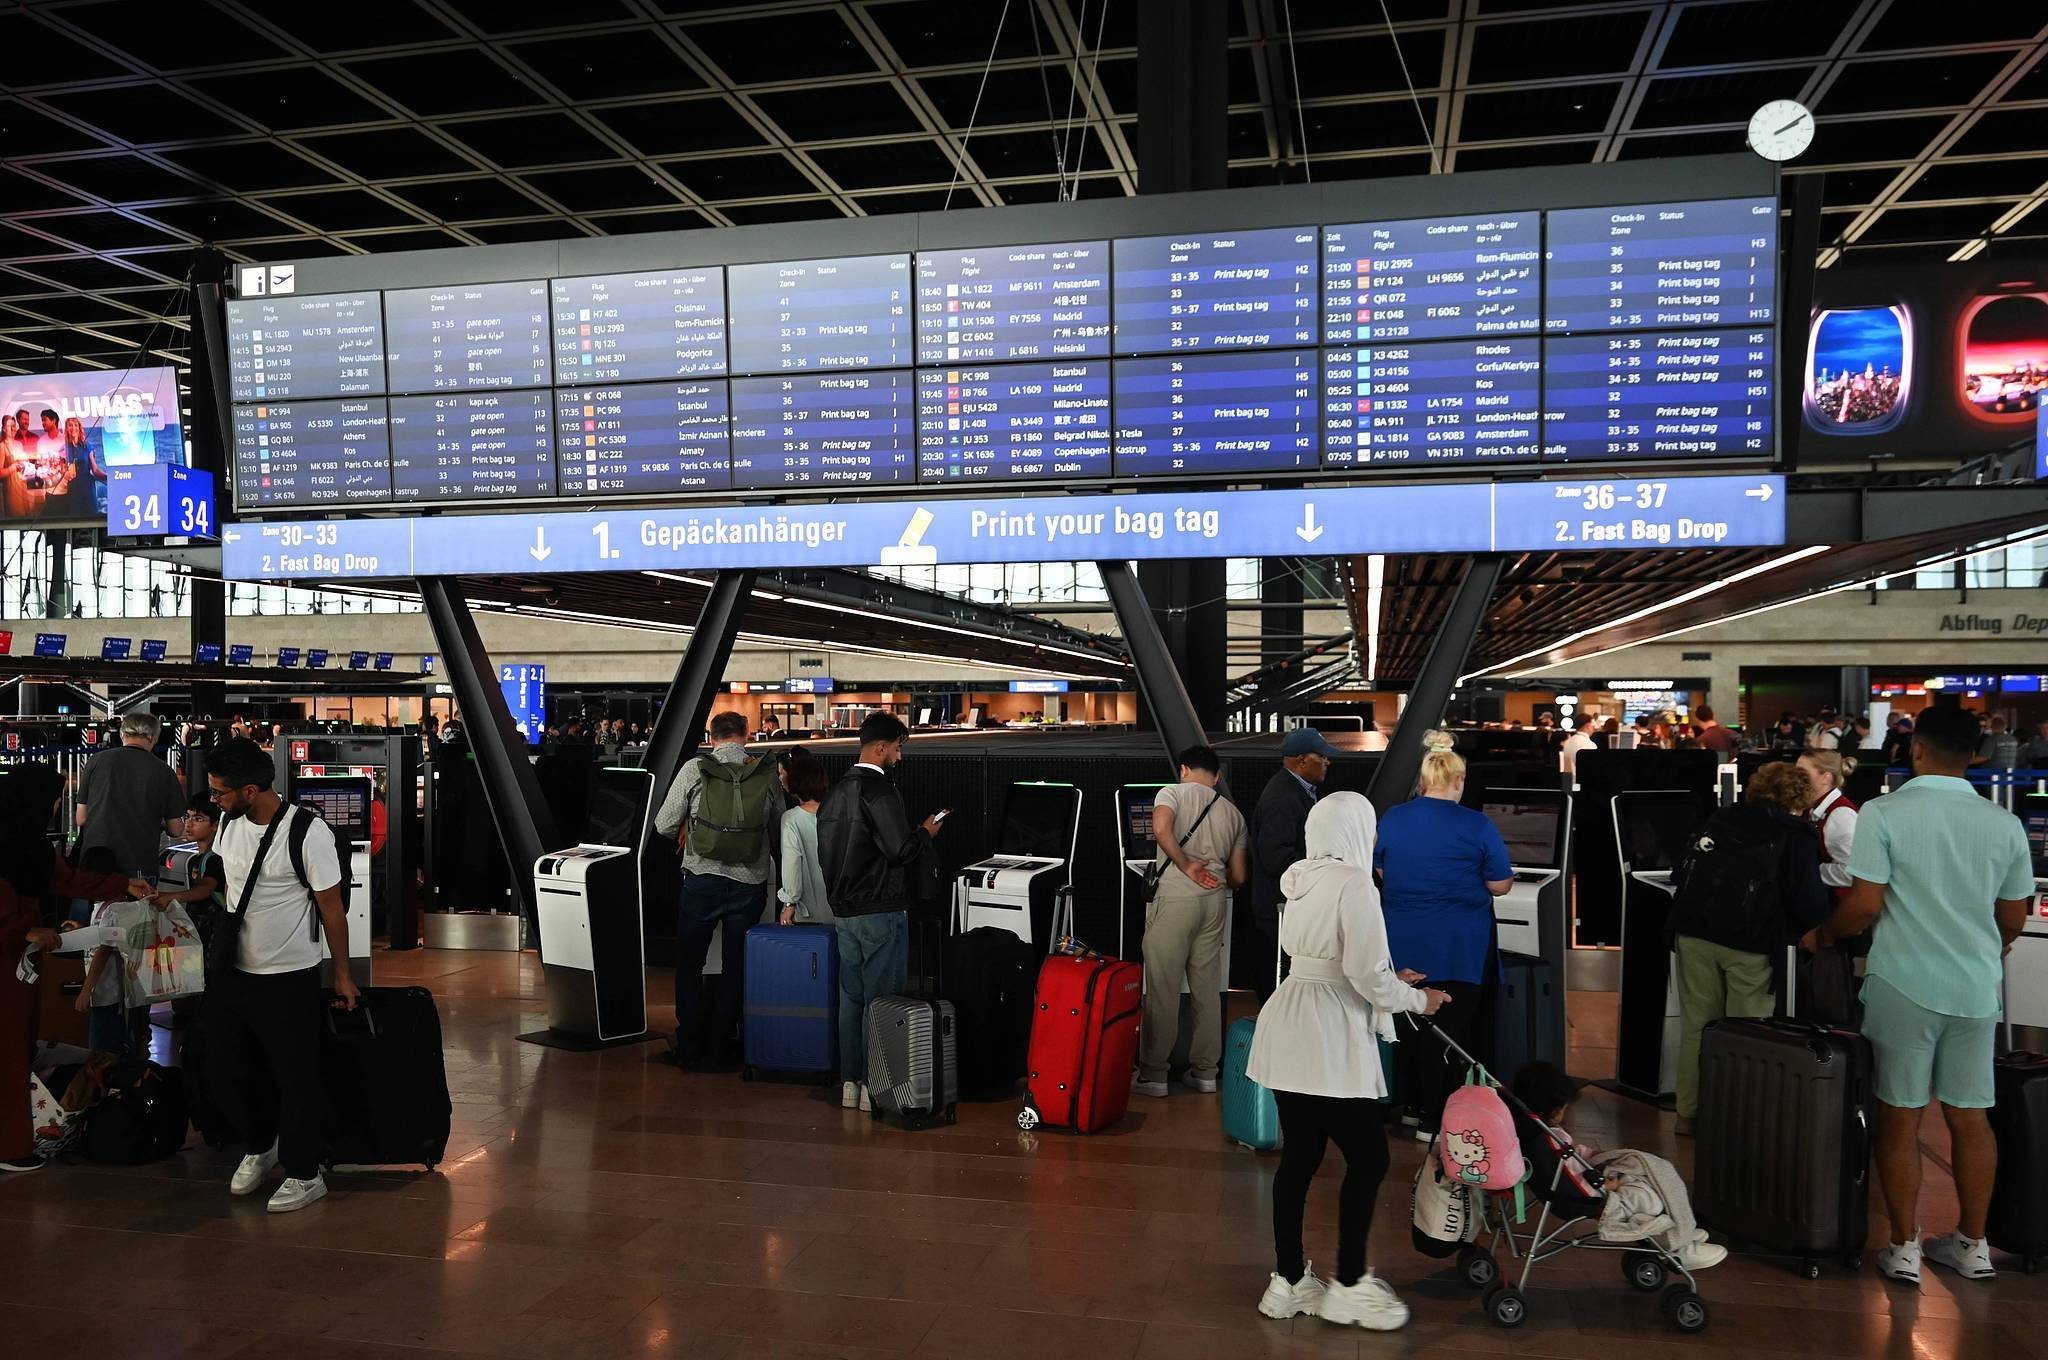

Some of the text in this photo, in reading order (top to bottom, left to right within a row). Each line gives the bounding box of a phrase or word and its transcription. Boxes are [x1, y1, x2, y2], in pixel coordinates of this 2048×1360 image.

[1171, 242, 1200, 251] Check-In
[1296, 235, 1313, 243] Gate
[1327, 259, 1413, 273] 21:00 EJU 2995
[1611, 260, 1721, 273] 35 Print bag tag
[921, 279, 1100, 296] 18:40 Amsterdam
[557, 313, 575, 321] 15:30
[605, 309, 618, 317] 402
[675, 304, 705, 313] Chisinau
[921, 301, 991, 312] 18:50 TW 404
[922, 312, 1082, 328] 19:10 Madrid
[1327, 313, 1352, 323] 22:10
[337, 325, 375, 334] Amsterdam
[1327, 321, 1519, 339] 04:45 Palma de
[559, 349, 713, 365] 15:50 MNE 301 Podgorica
[922, 344, 1085, 359] 19:20 Helsinki
[1328, 345, 1511, 362] 04:45 Rhodes
[922, 367, 1086, 383] 19:30 İstanbul
[1327, 361, 1539, 379] 05:00 Corfu/Kerkyra
[486, 377, 500, 386] bag
[501, 377, 512, 385] tag
[783, 379, 869, 390] 34 Print bag tag
[1327, 380, 1493, 395] 05:25 X3 4604 Kos
[922, 383, 1082, 399] 19:45 IB 766 Madrid
[1609, 387, 1767, 401] 32 H51
[62, 393, 143, 418] LUMAS
[269, 408, 277, 416] PC
[342, 404, 368, 412] İstanbul
[561, 408, 579, 416] 17:35
[608, 406, 621, 414] 996
[678, 401, 707, 411] İstanbul
[922, 399, 1109, 414] 20:10 Milano-Linate
[1328, 396, 1509, 412] 06:30 Madrid
[1172, 408, 1269, 420] 34 Print bag tag
[562, 431, 722, 446] 18:30 İzmir Adnan
[923, 429, 1142, 445] 20:20 JU 353 Belgrad Tesla
[1328, 429, 1529, 445] 07:00 KL 1814 Amsterdam
[680, 448, 705, 456] Almaty
[895, 454, 905, 462] H1
[114, 471, 132, 480] Zone
[173, 470, 187, 481] Zone
[439, 472, 447, 480] 33
[490, 470, 503, 479] bag
[504, 471, 516, 479] tag
[564, 467, 582, 475] 18:30
[610, 465, 627, 473] 1319
[681, 462, 698, 470] Paris
[923, 463, 1081, 476] 20:40 Dublin
[564, 482, 583, 490] 18:30
[1555, 486, 1581, 498] Zone
[124, 495, 161, 530] 34
[181, 497, 208, 533] 34
[971, 506, 1219, 542] Print your bag tag
[1555, 518, 1728, 544] 2. Fast Bag Drop
[262, 527, 280, 537] Zone
[592, 516, 847, 559] 1. Gepäckanhänger
[262, 553, 378, 575] 2. Fast Bag Drop
[1939, 614, 2002, 634] Abflug
[503, 667, 515, 680] 2.
[1444, 1204, 1461, 1233] HOT
